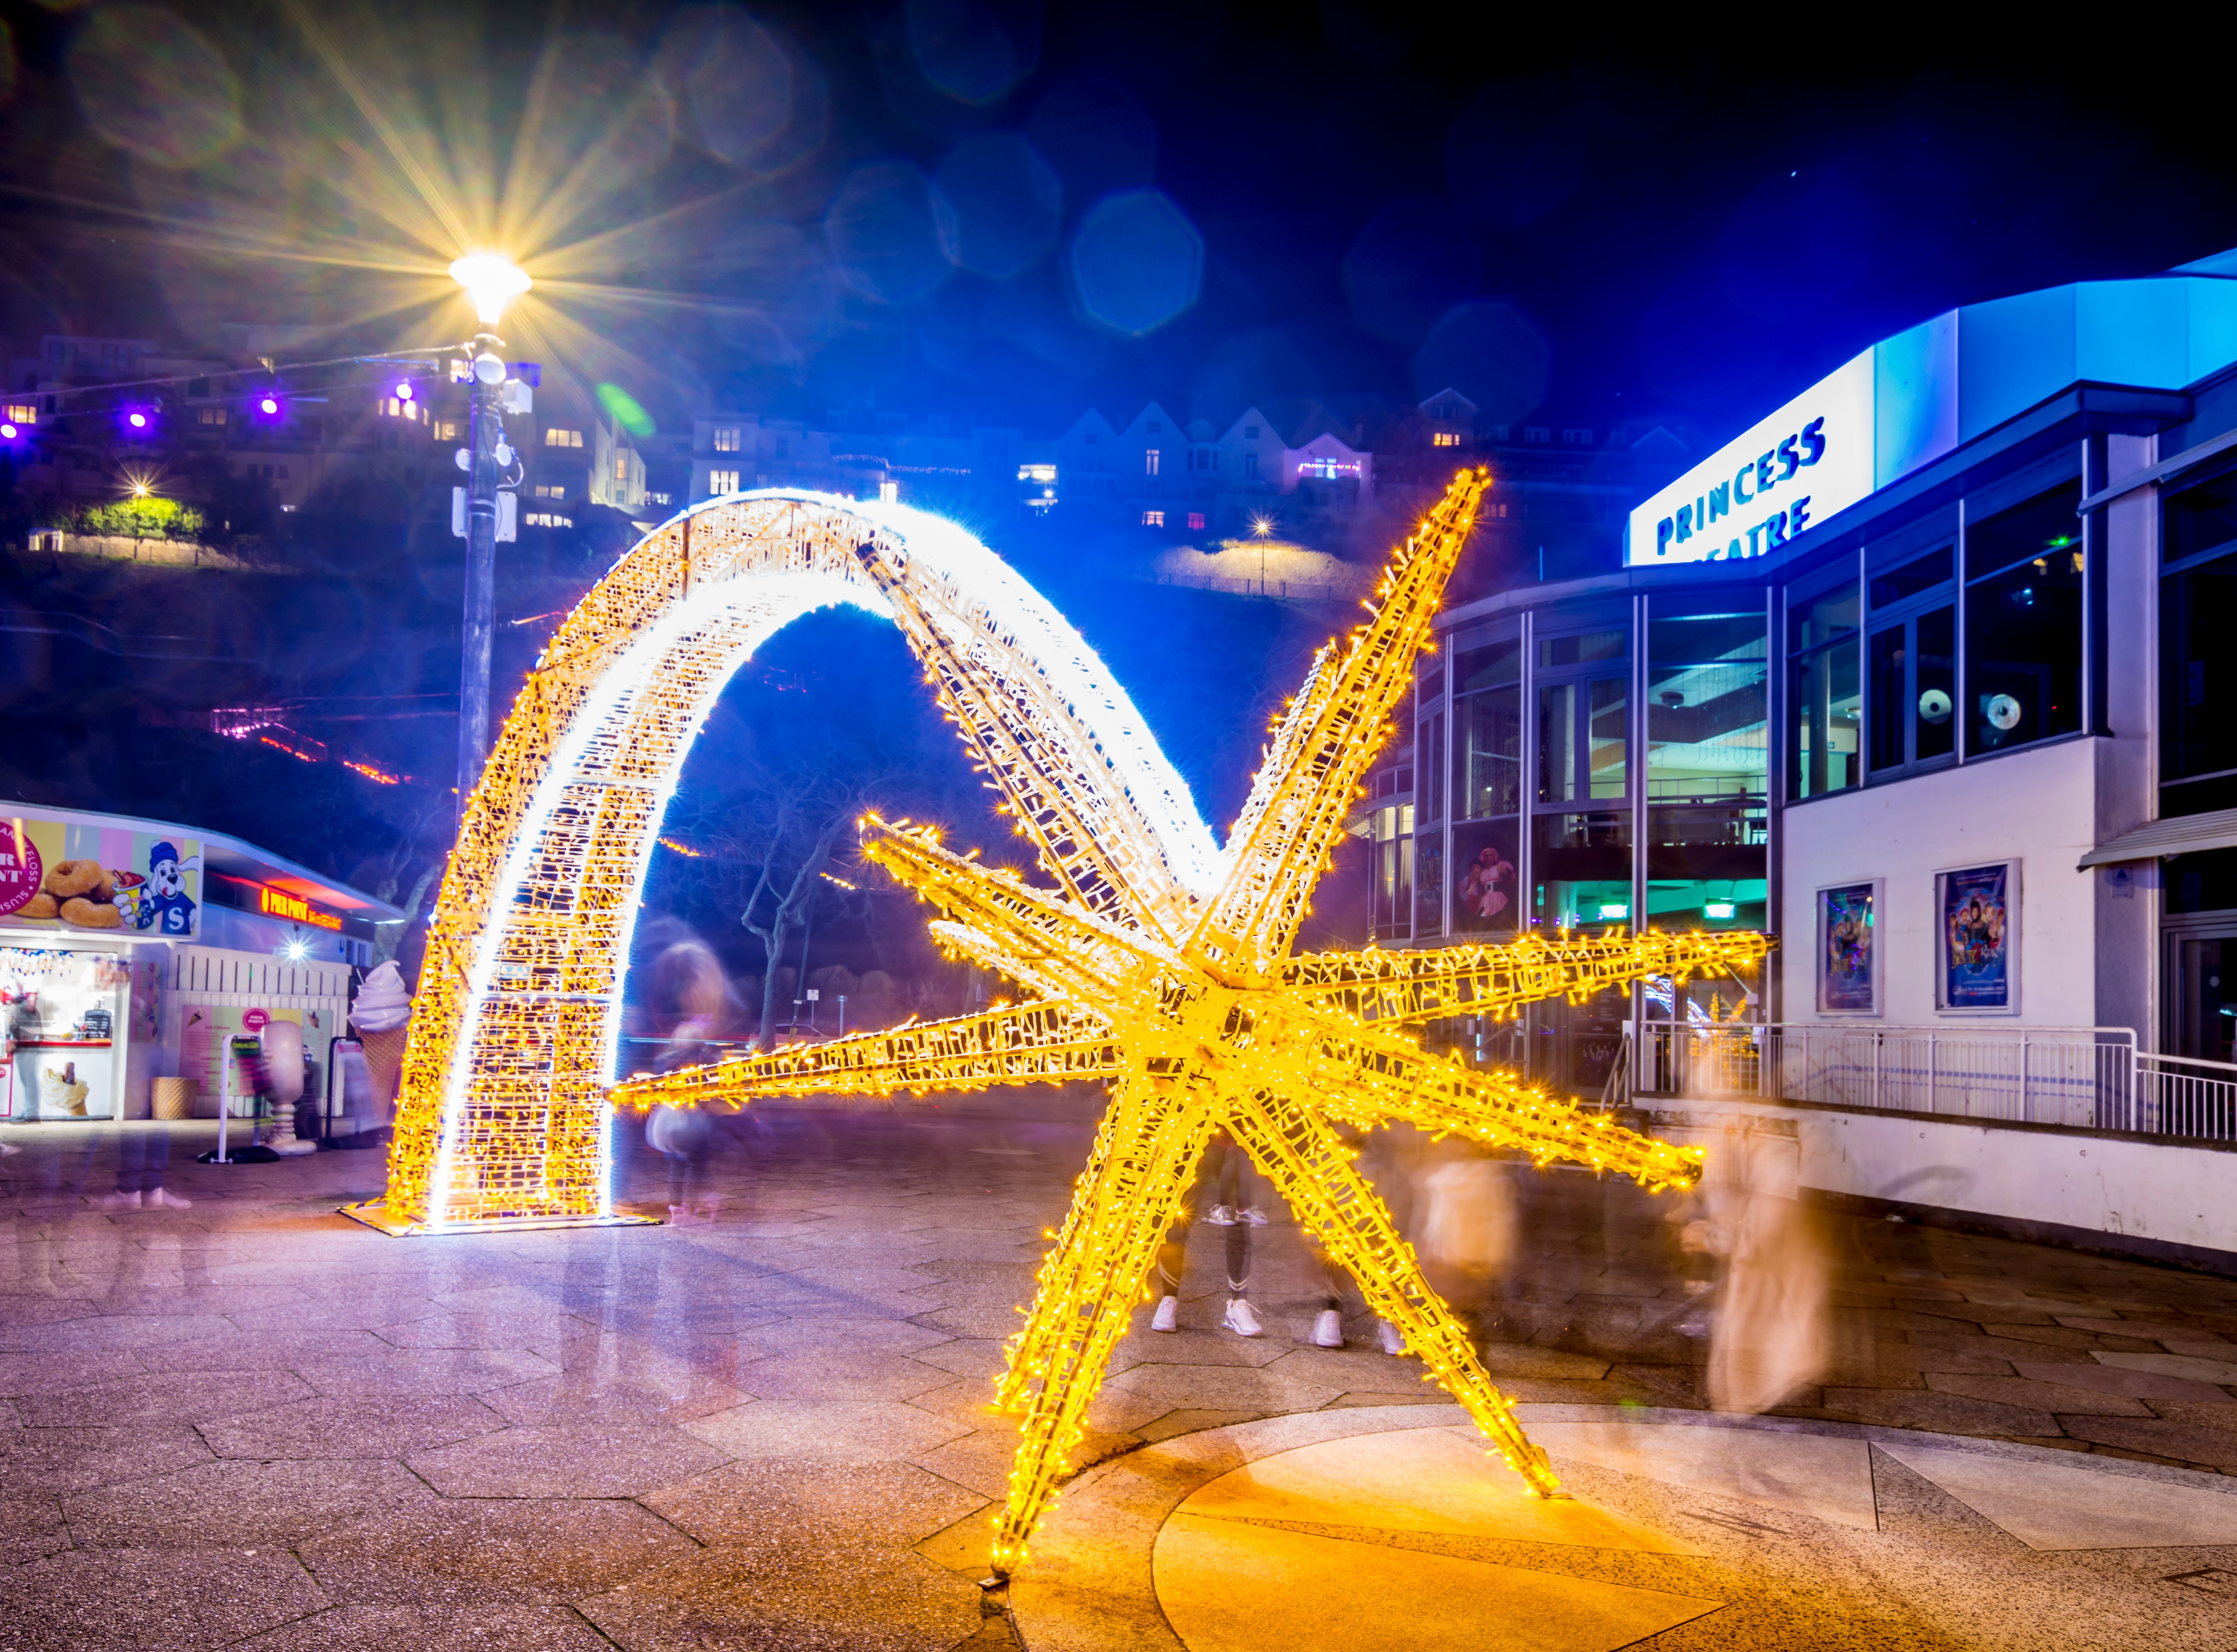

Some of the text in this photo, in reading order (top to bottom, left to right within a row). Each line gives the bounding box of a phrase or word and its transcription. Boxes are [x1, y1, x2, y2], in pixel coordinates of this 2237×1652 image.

[1657, 416, 1826, 555] PRINCESS
[1693, 495, 1811, 561] ATRE
[26, 850, 38, 883] FLOSS
[270, 892, 288, 916] PIER
[287, 897, 309, 921] POINT
